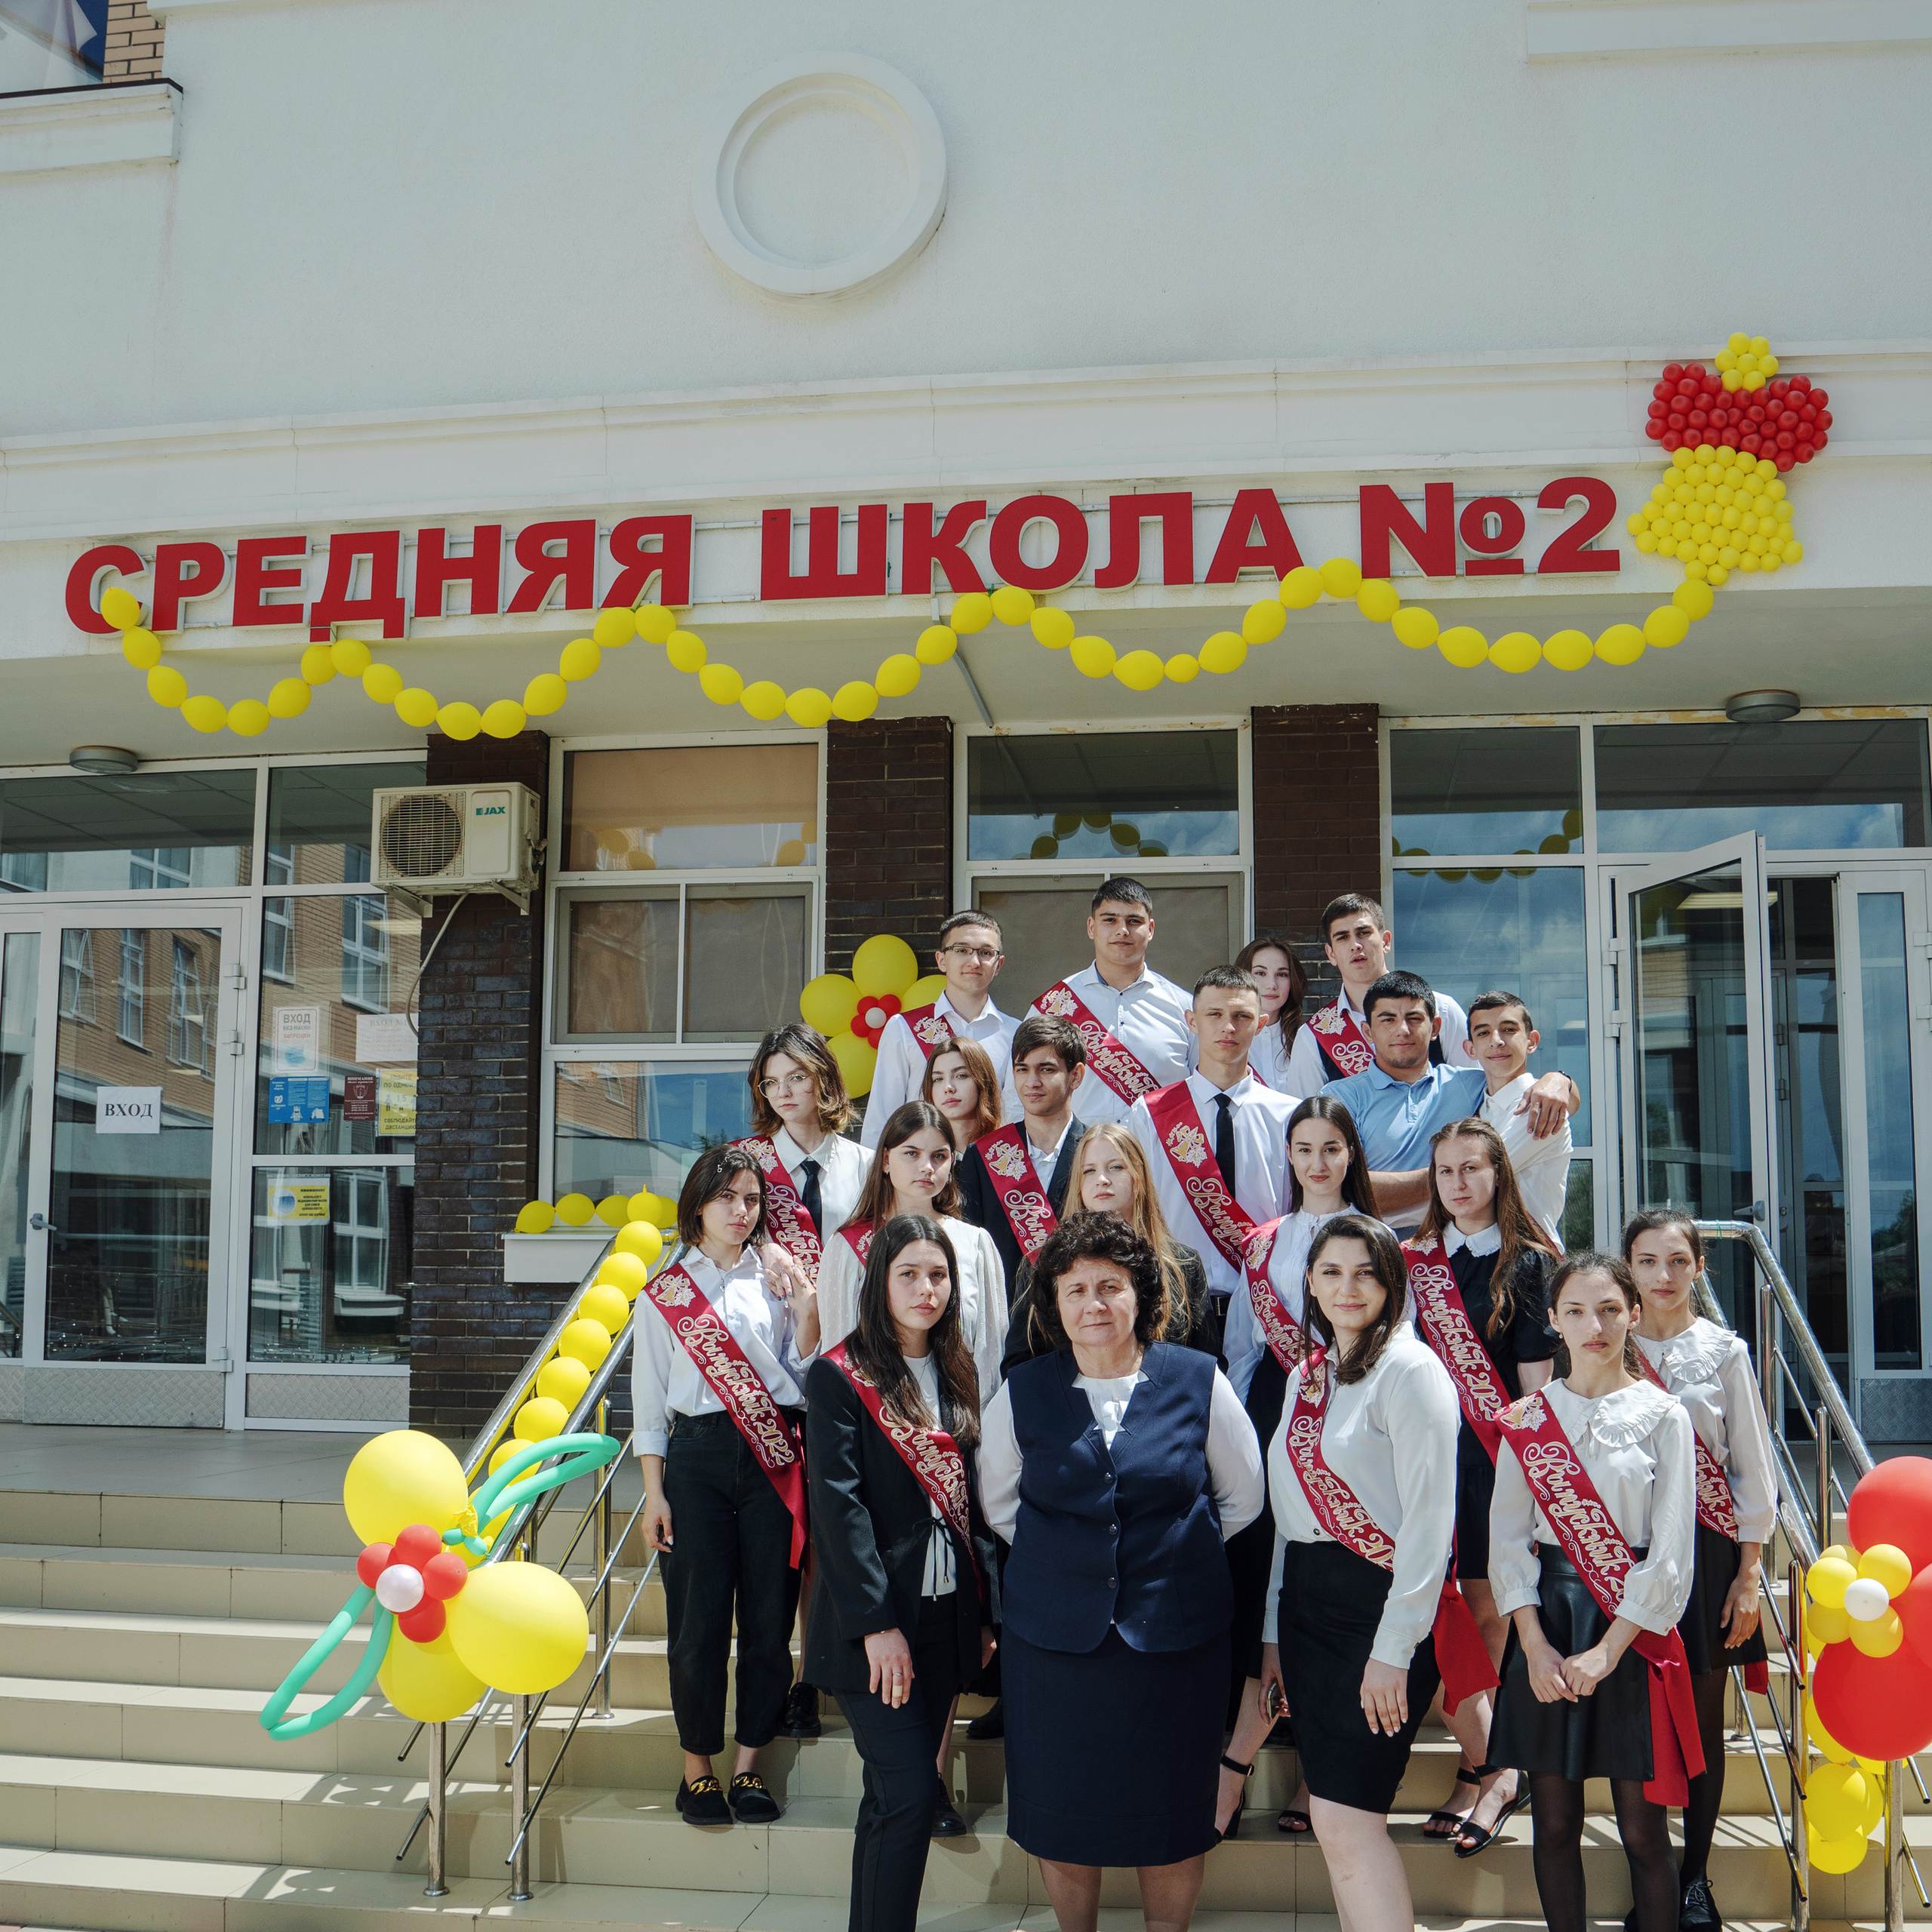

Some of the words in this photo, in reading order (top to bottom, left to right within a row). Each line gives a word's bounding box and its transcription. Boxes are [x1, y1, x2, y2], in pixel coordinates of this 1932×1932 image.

[66, 515, 694, 643] СРЕДНЯЯ
[761, 488, 1306, 601] ШКОЛА
[1360, 477, 1620, 579] №2
[284, 1014, 311, 1025] ВХОД
[105, 1103, 153, 1119] ВХОД
[1411, 1263, 1491, 1374] Выпускник
[678, 1313, 778, 1422] Выпускник
[753, 1418, 795, 1466] 2022
[1522, 1441, 1637, 1576] Выпускник
